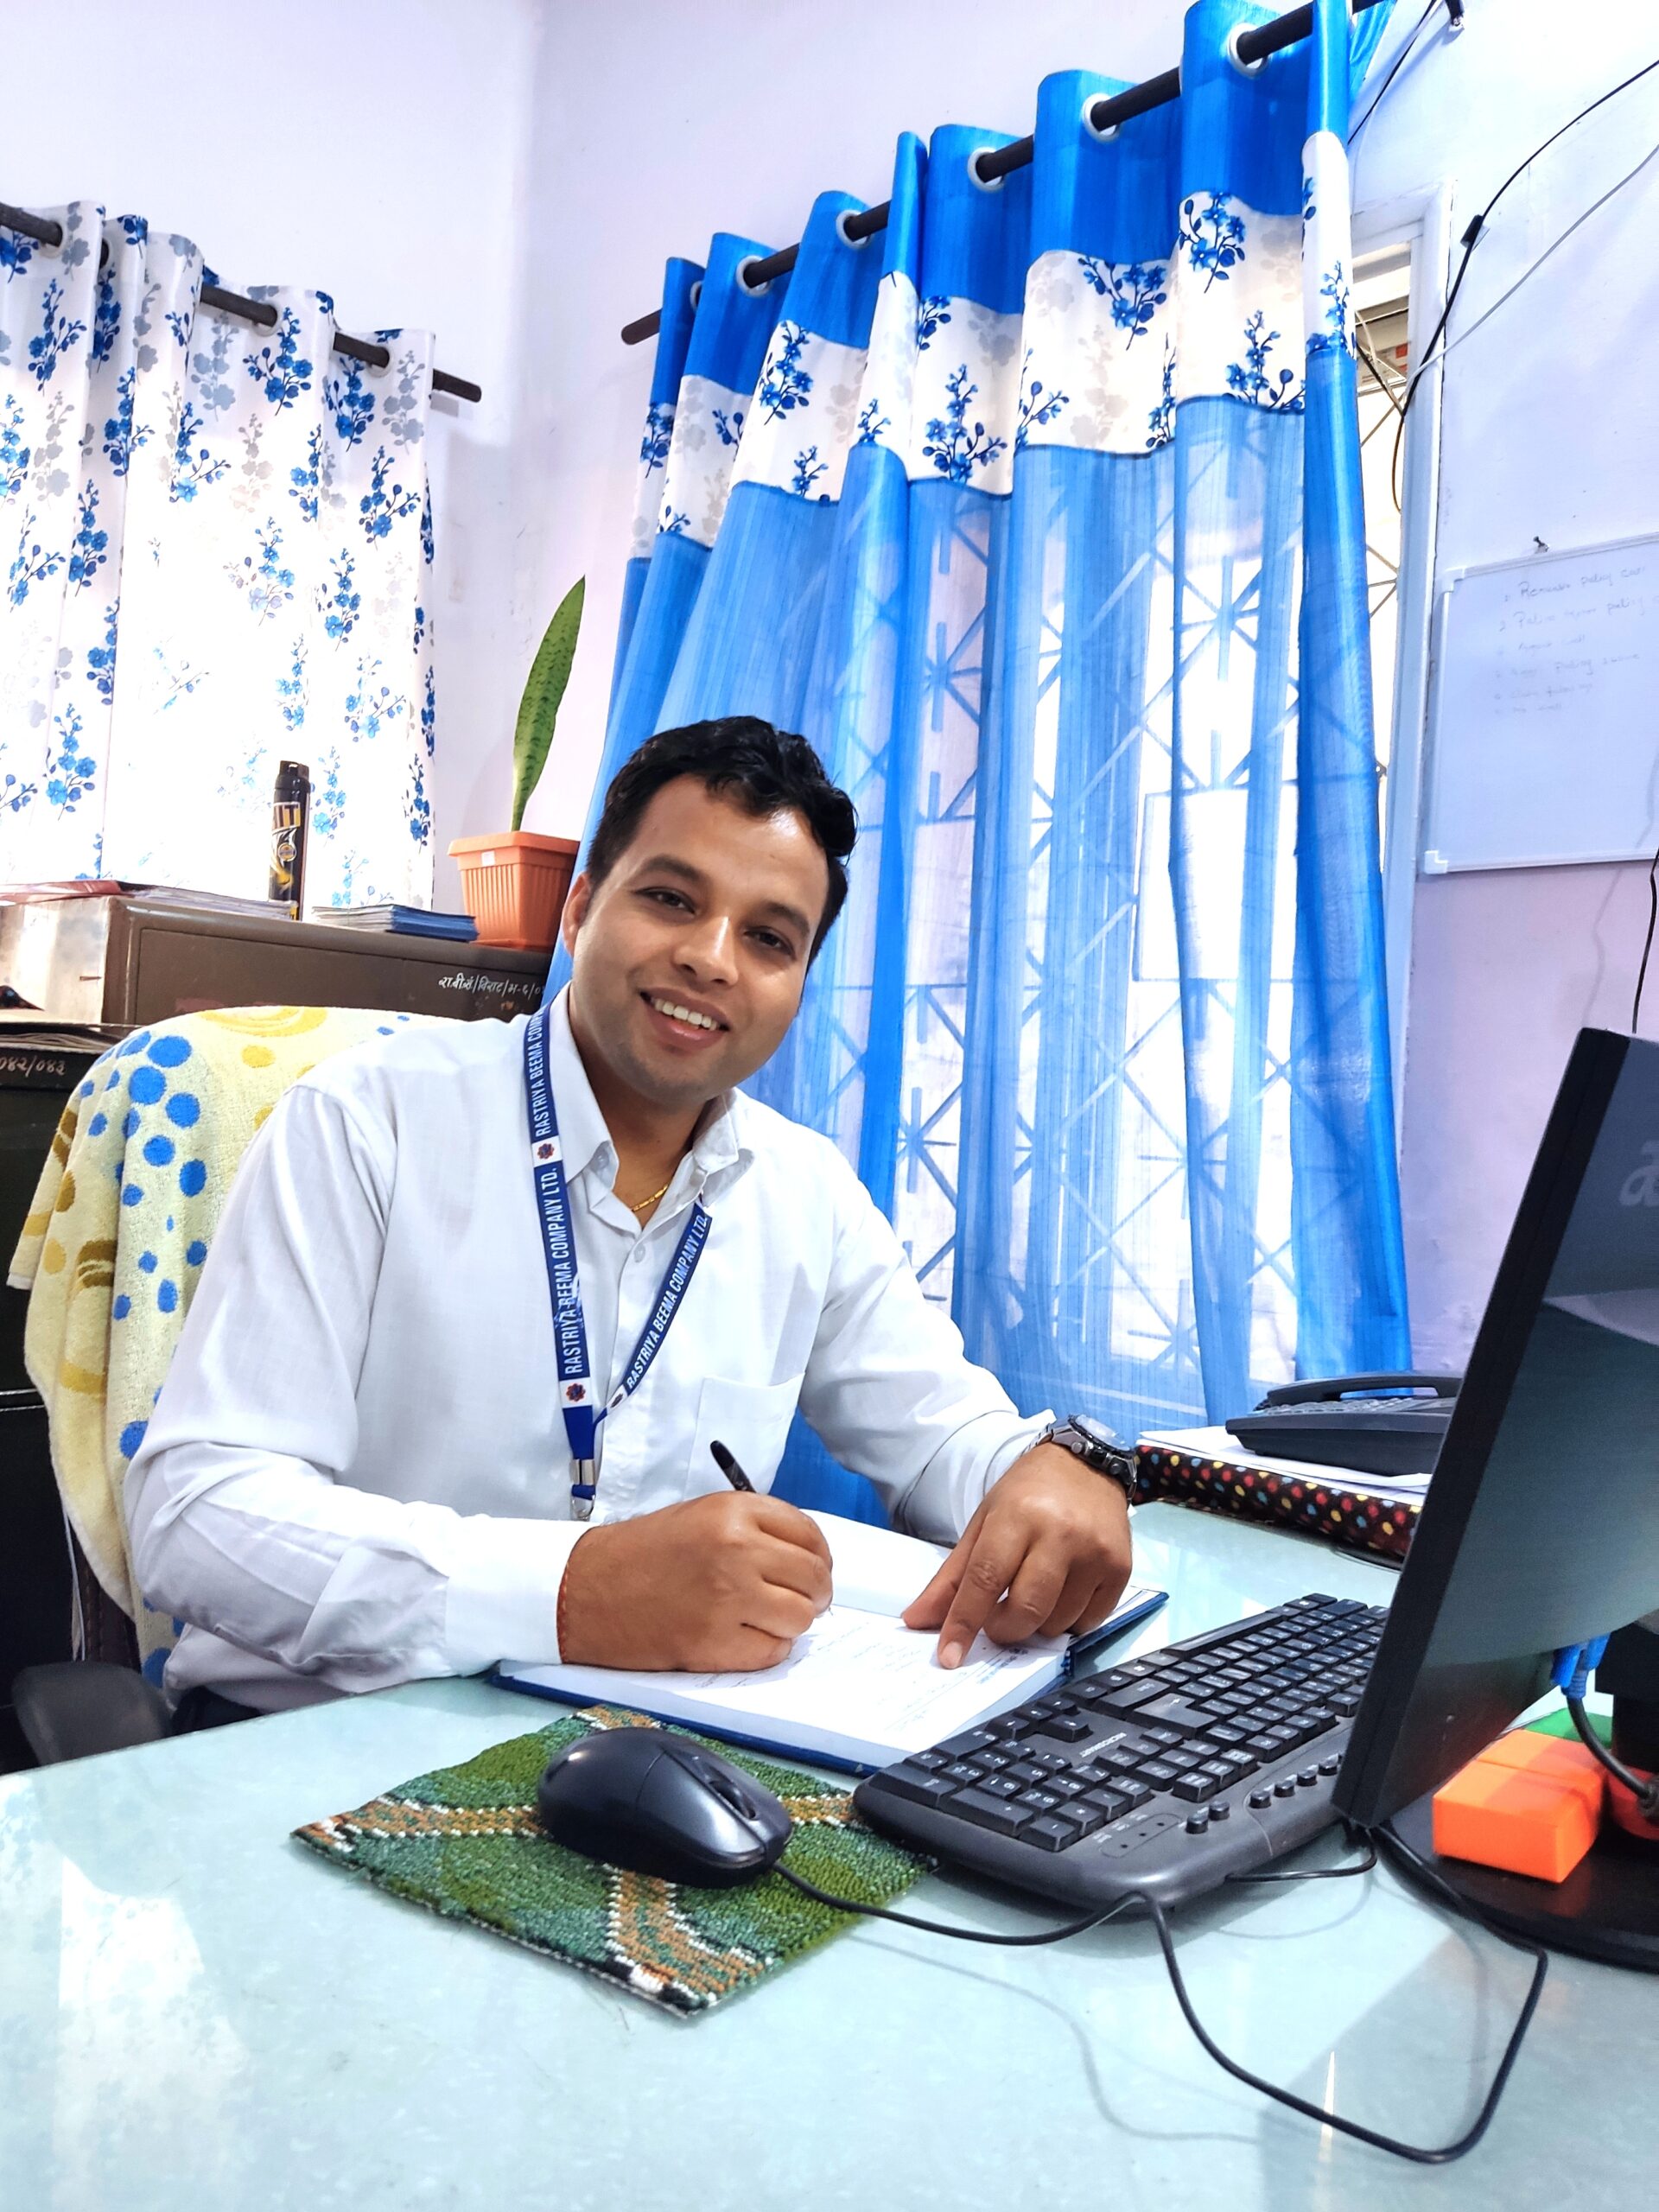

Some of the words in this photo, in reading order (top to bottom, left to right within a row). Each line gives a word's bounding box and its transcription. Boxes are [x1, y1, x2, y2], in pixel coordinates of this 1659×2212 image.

[528, 1040, 543, 1079] BEEMA
[531, 1078, 551, 1137] RASTRIYA
[540, 1167, 560, 1195] LTD.
[545, 1198, 569, 1259] COMPANY
[560, 1306, 582, 1375] RASTRIYA
[626, 1331, 660, 1389] RASTRIYA
[652, 1290, 677, 1332] BEEMA
[669, 1235, 700, 1293] COMPANY
